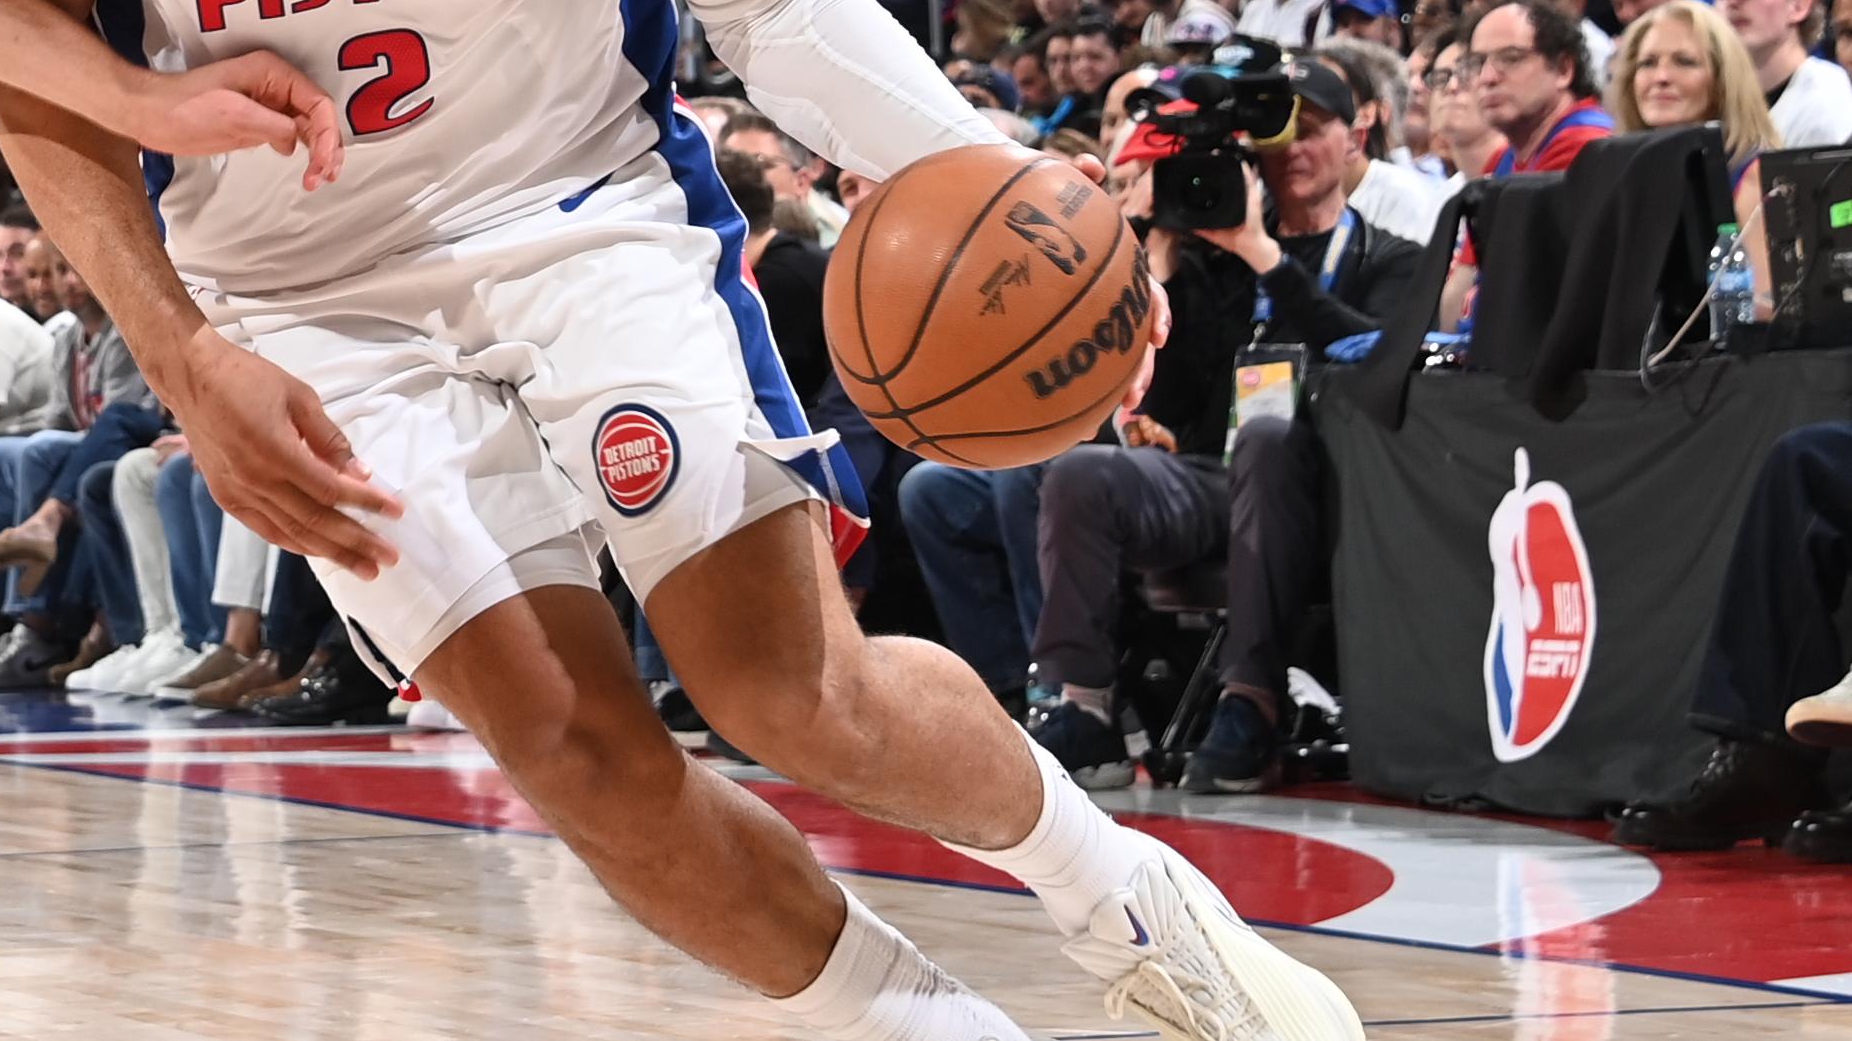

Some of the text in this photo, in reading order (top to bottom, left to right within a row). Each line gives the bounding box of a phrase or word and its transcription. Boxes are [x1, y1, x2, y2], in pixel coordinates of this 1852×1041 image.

[337, 27, 435, 136] 2
[603, 436, 656, 465] DETROIT
[608, 453, 661, 483] PISTONS
[1552, 581, 1584, 635] NBA
[1526, 639, 1581, 678] ESPN
